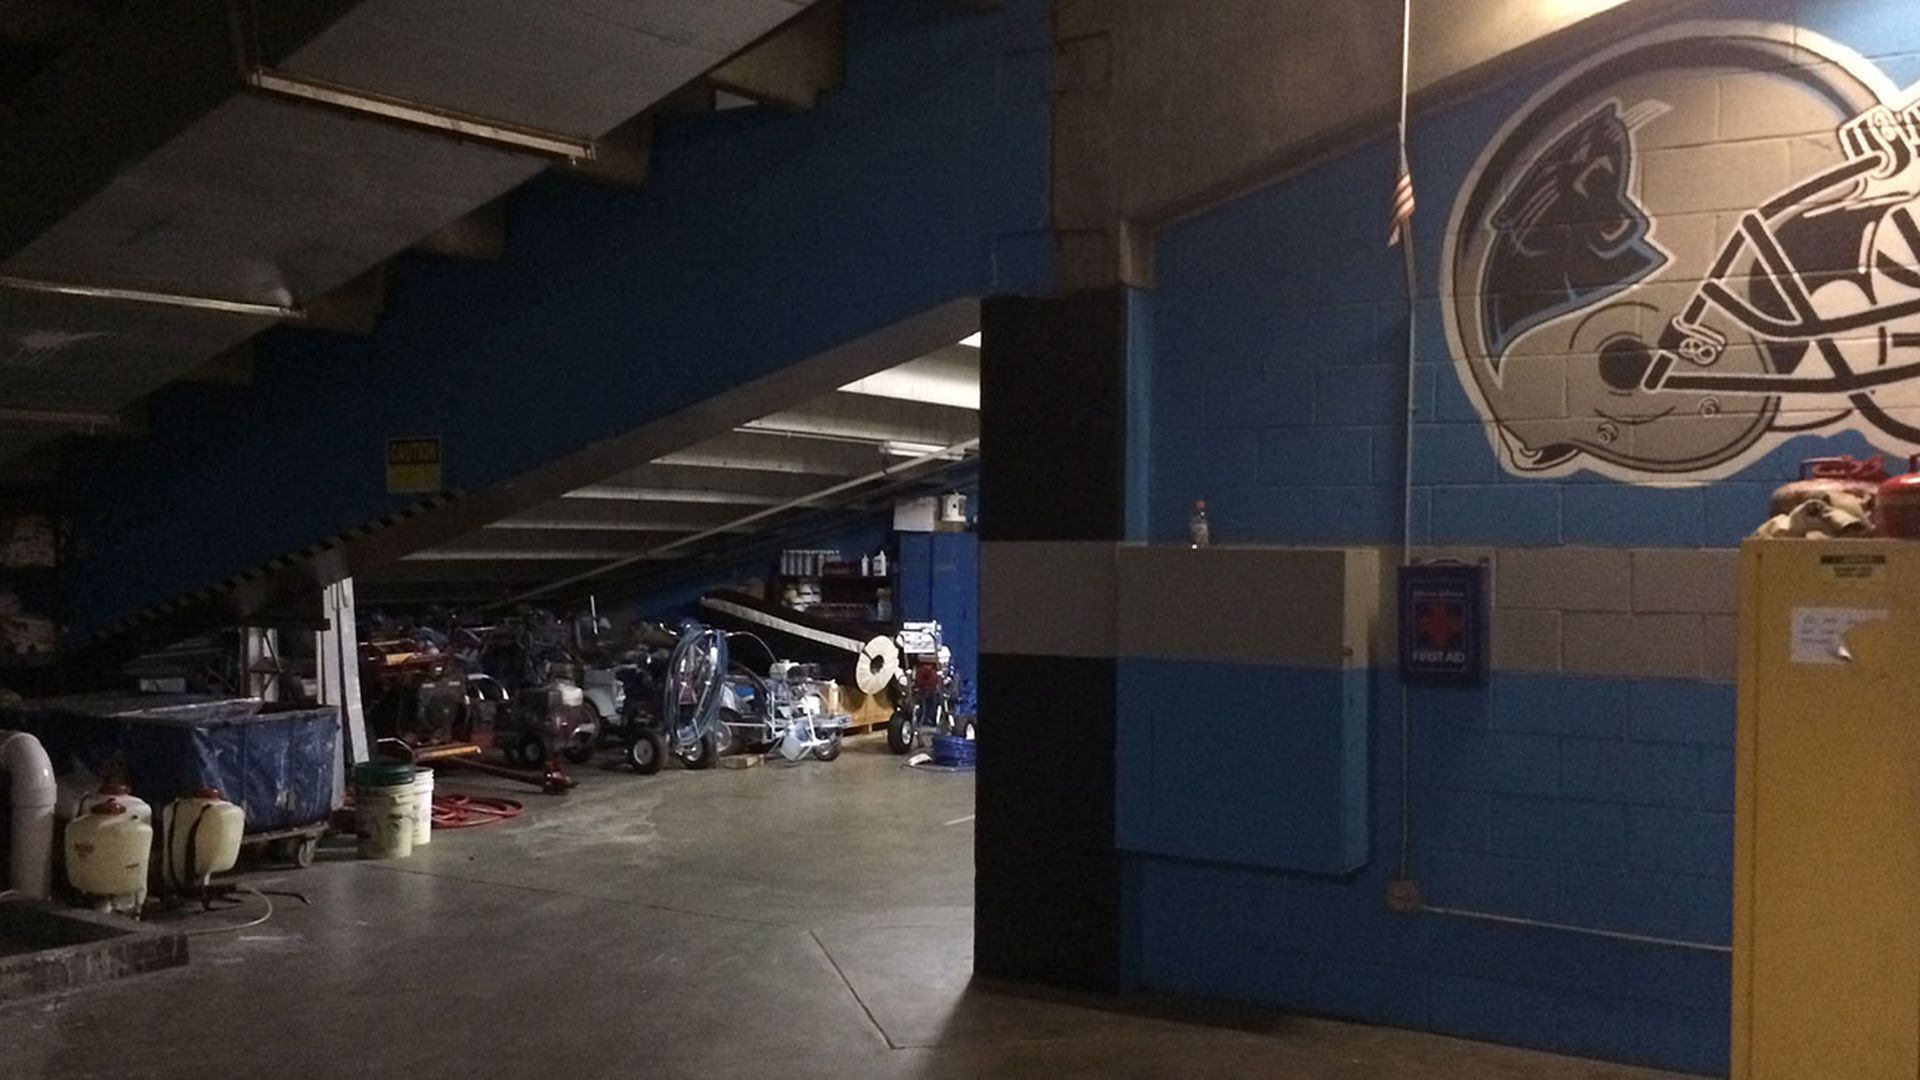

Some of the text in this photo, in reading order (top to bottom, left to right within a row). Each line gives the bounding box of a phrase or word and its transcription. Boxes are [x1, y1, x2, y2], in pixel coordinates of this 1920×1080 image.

[391, 442, 437, 461] CAUTION
[1412, 651, 1465, 663] FIRST AID
